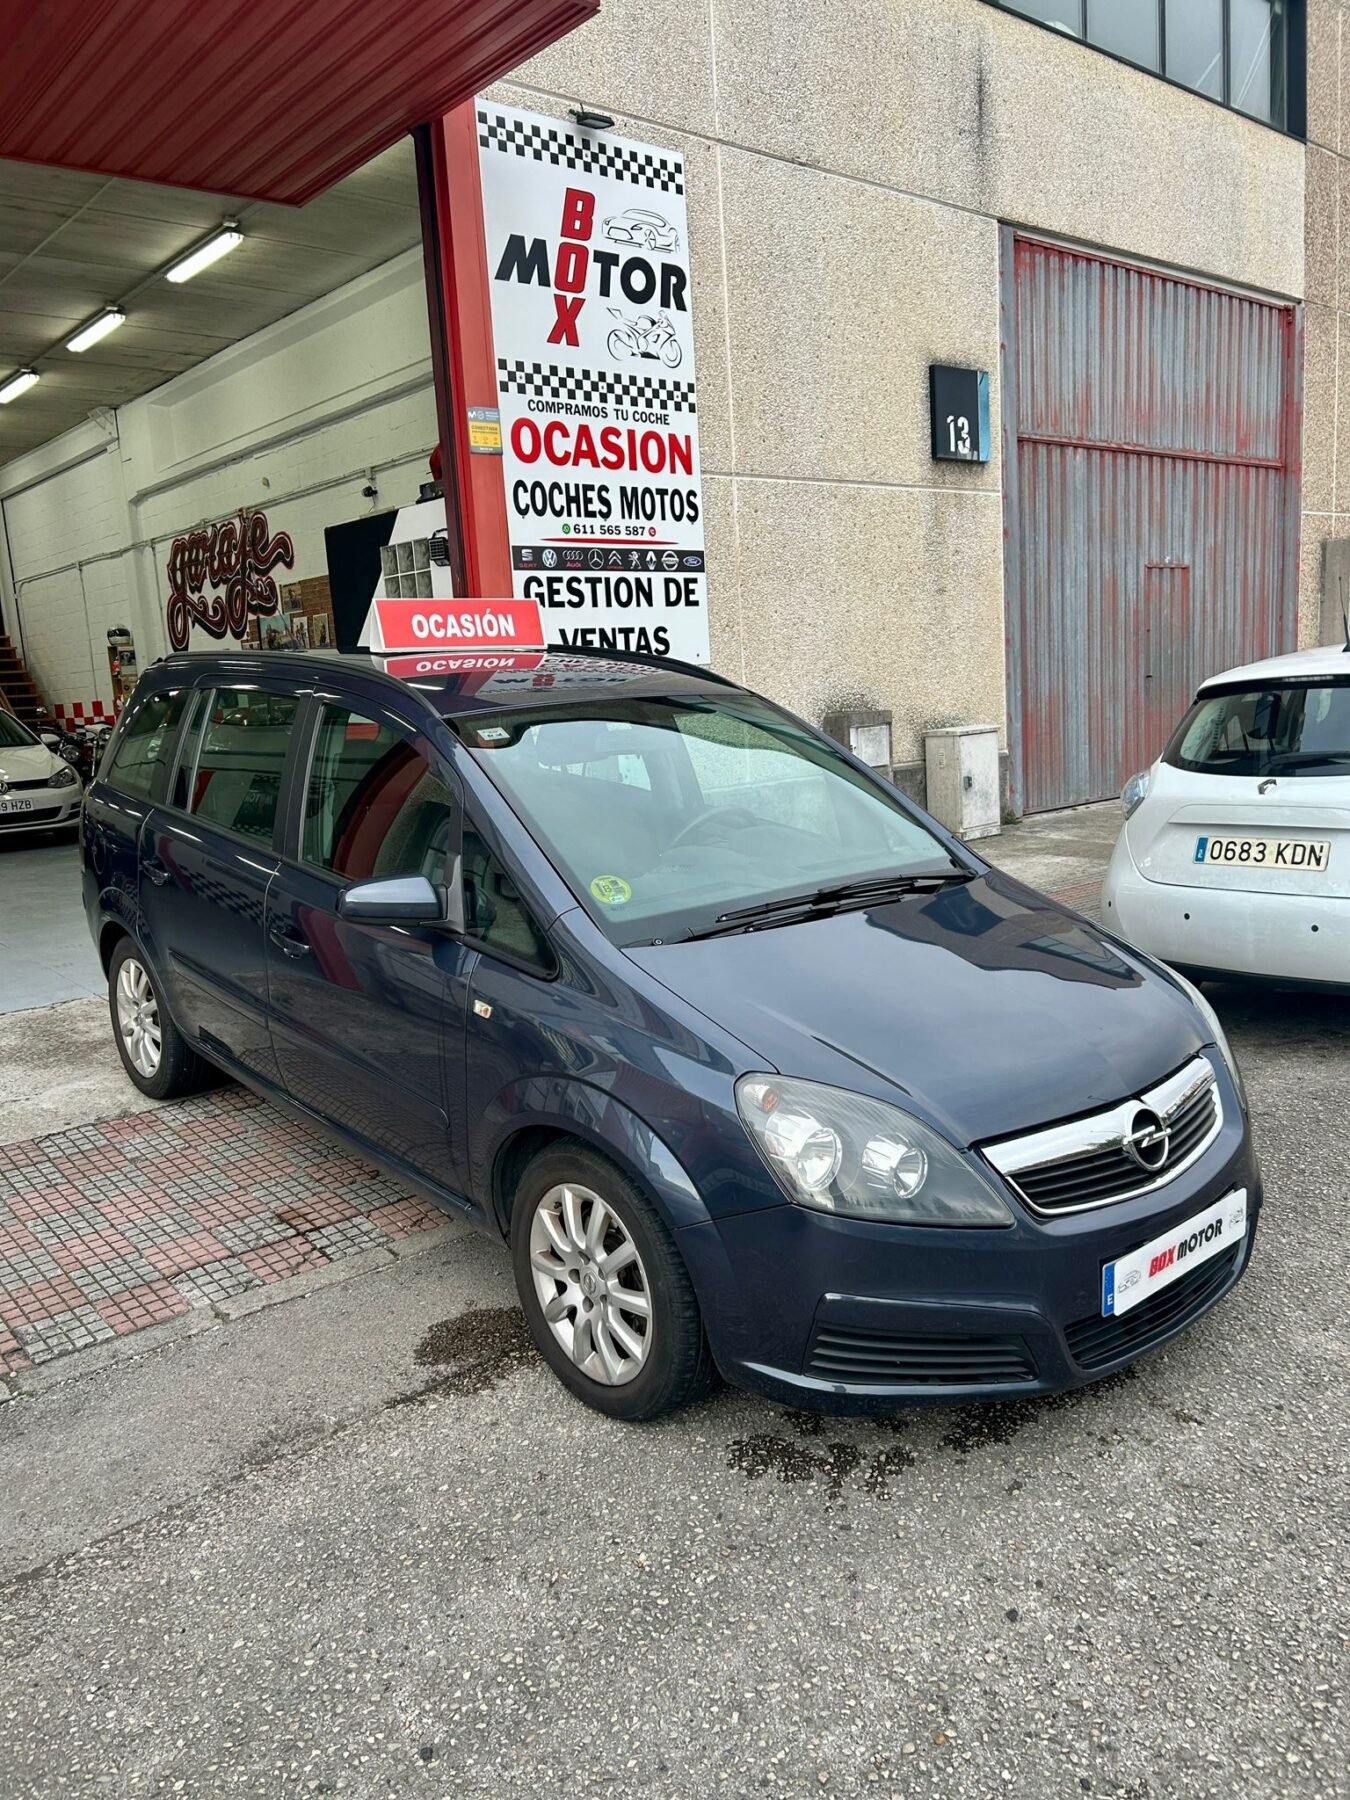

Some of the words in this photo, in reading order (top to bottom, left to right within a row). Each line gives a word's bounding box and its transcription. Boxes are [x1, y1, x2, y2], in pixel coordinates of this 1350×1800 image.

[547, 187, 595, 347] BOX
[528, 399, 608, 419] COMPRAMOS
[614, 408, 629, 421] TU
[633, 411, 670, 425] COCHE
[511, 417, 692, 475] OCASION
[946, 415, 971, 454] 13
[513, 479, 612, 520] COCHES
[619, 486, 699, 523] MOTOS
[573, 523, 596, 535] 611
[599, 525, 621, 535] 565
[625, 526, 645, 537] 587
[524, 576, 653, 608] GESTION
[664, 577, 700, 607] DE
[411, 608, 516, 638] OCASIÓN
[559, 626, 671, 656] VENTAS
[11, 800, 32, 811] HZB
[1210, 840, 1267, 863] 0683
[1274, 842, 1324, 867] KDN
[1149, 1245, 1176, 1278] BOX
[1177, 1218, 1223, 1261] MOTOR
[1107, 1294, 1114, 1306] E
